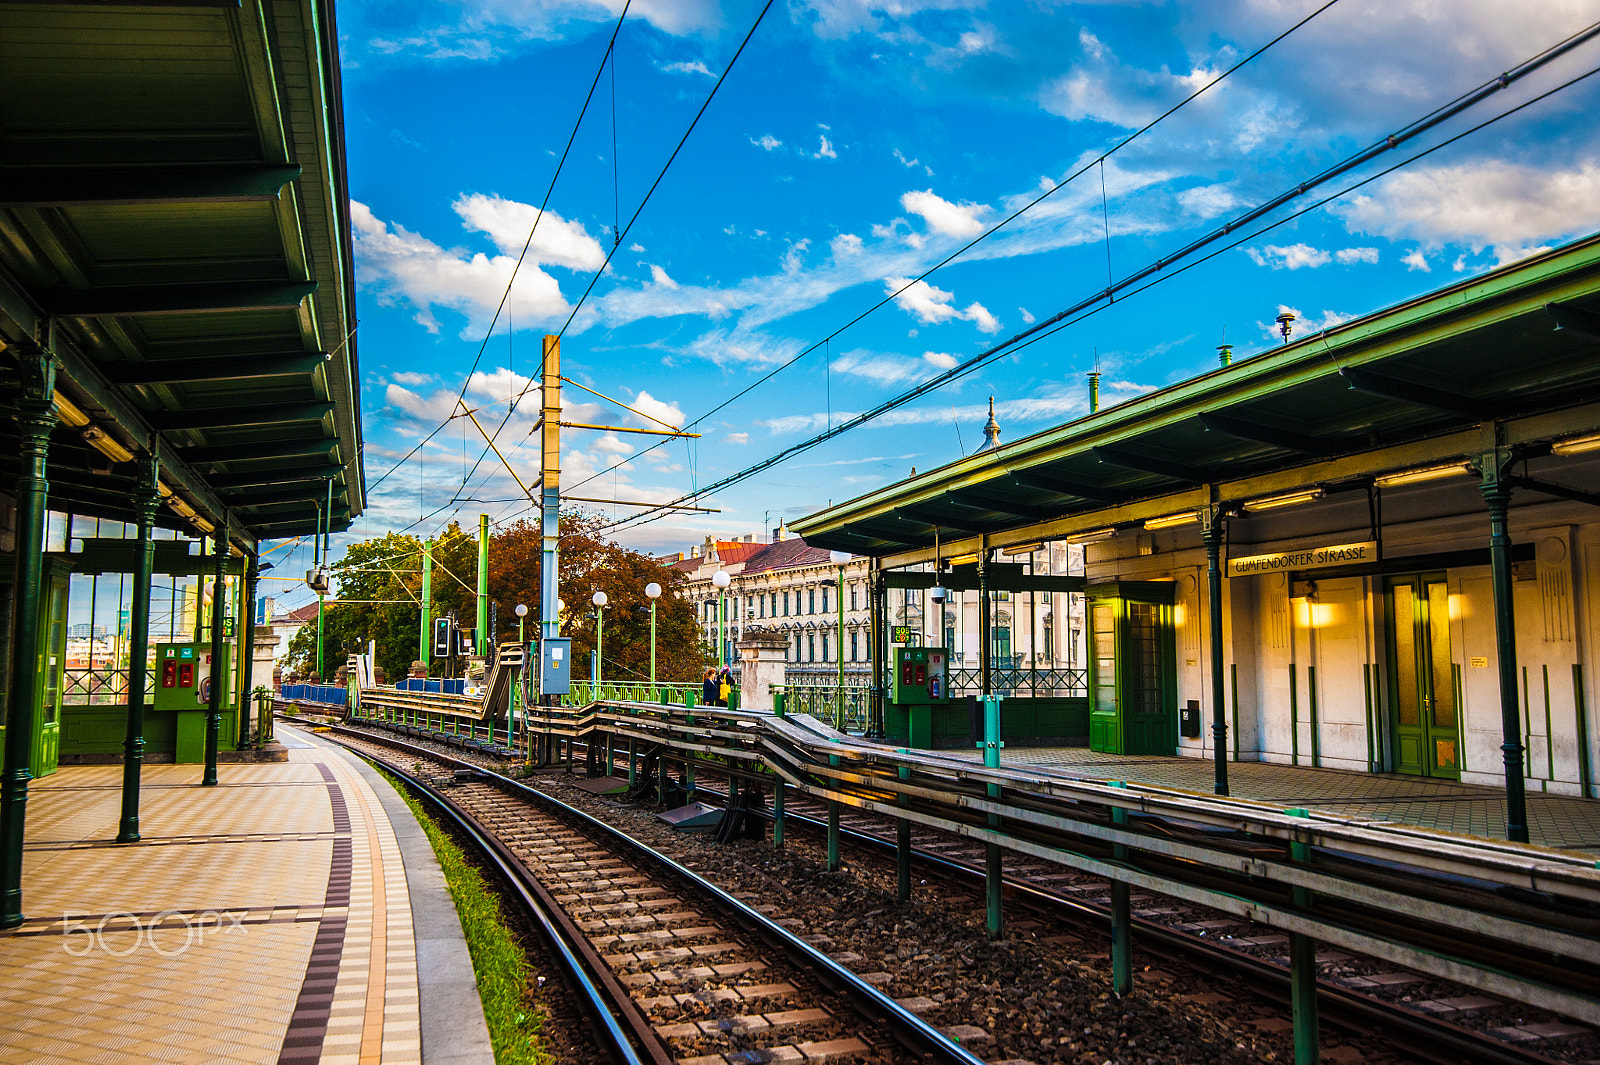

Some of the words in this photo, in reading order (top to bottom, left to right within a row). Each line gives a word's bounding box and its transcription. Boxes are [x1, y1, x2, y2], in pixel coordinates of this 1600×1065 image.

[1235, 553, 1314, 573] GUMPENDORFER
[1317, 546, 1367, 564] STRASSE
[895, 626, 910, 635] SOS
